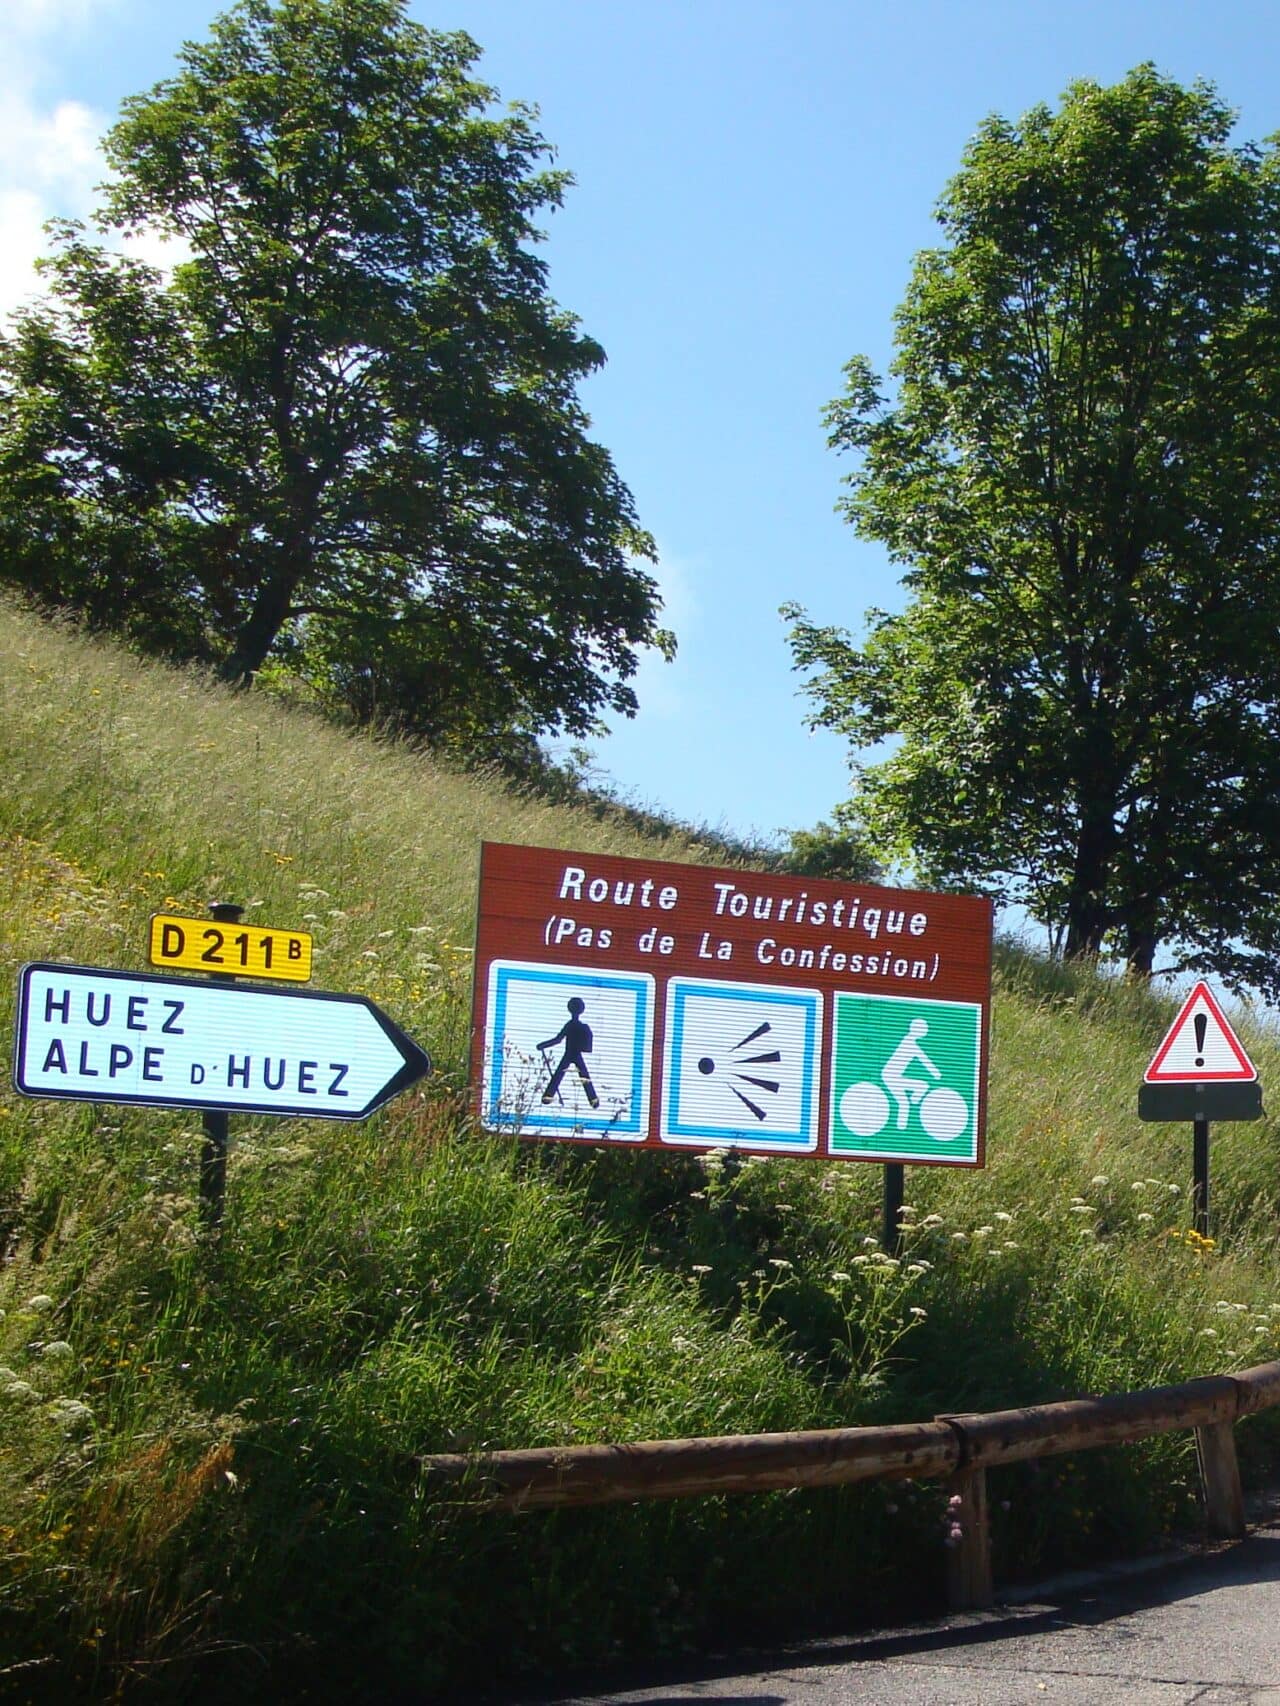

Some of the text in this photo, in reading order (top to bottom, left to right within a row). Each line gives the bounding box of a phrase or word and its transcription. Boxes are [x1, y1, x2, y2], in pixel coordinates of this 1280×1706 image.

[559, 867, 927, 938] Route Touristique
[161, 925, 184, 957] D
[544, 916, 939, 980] (Pas de La Confession)
[44, 988, 185, 1034] HUEZ
[42, 1038, 164, 1080] ALPE
